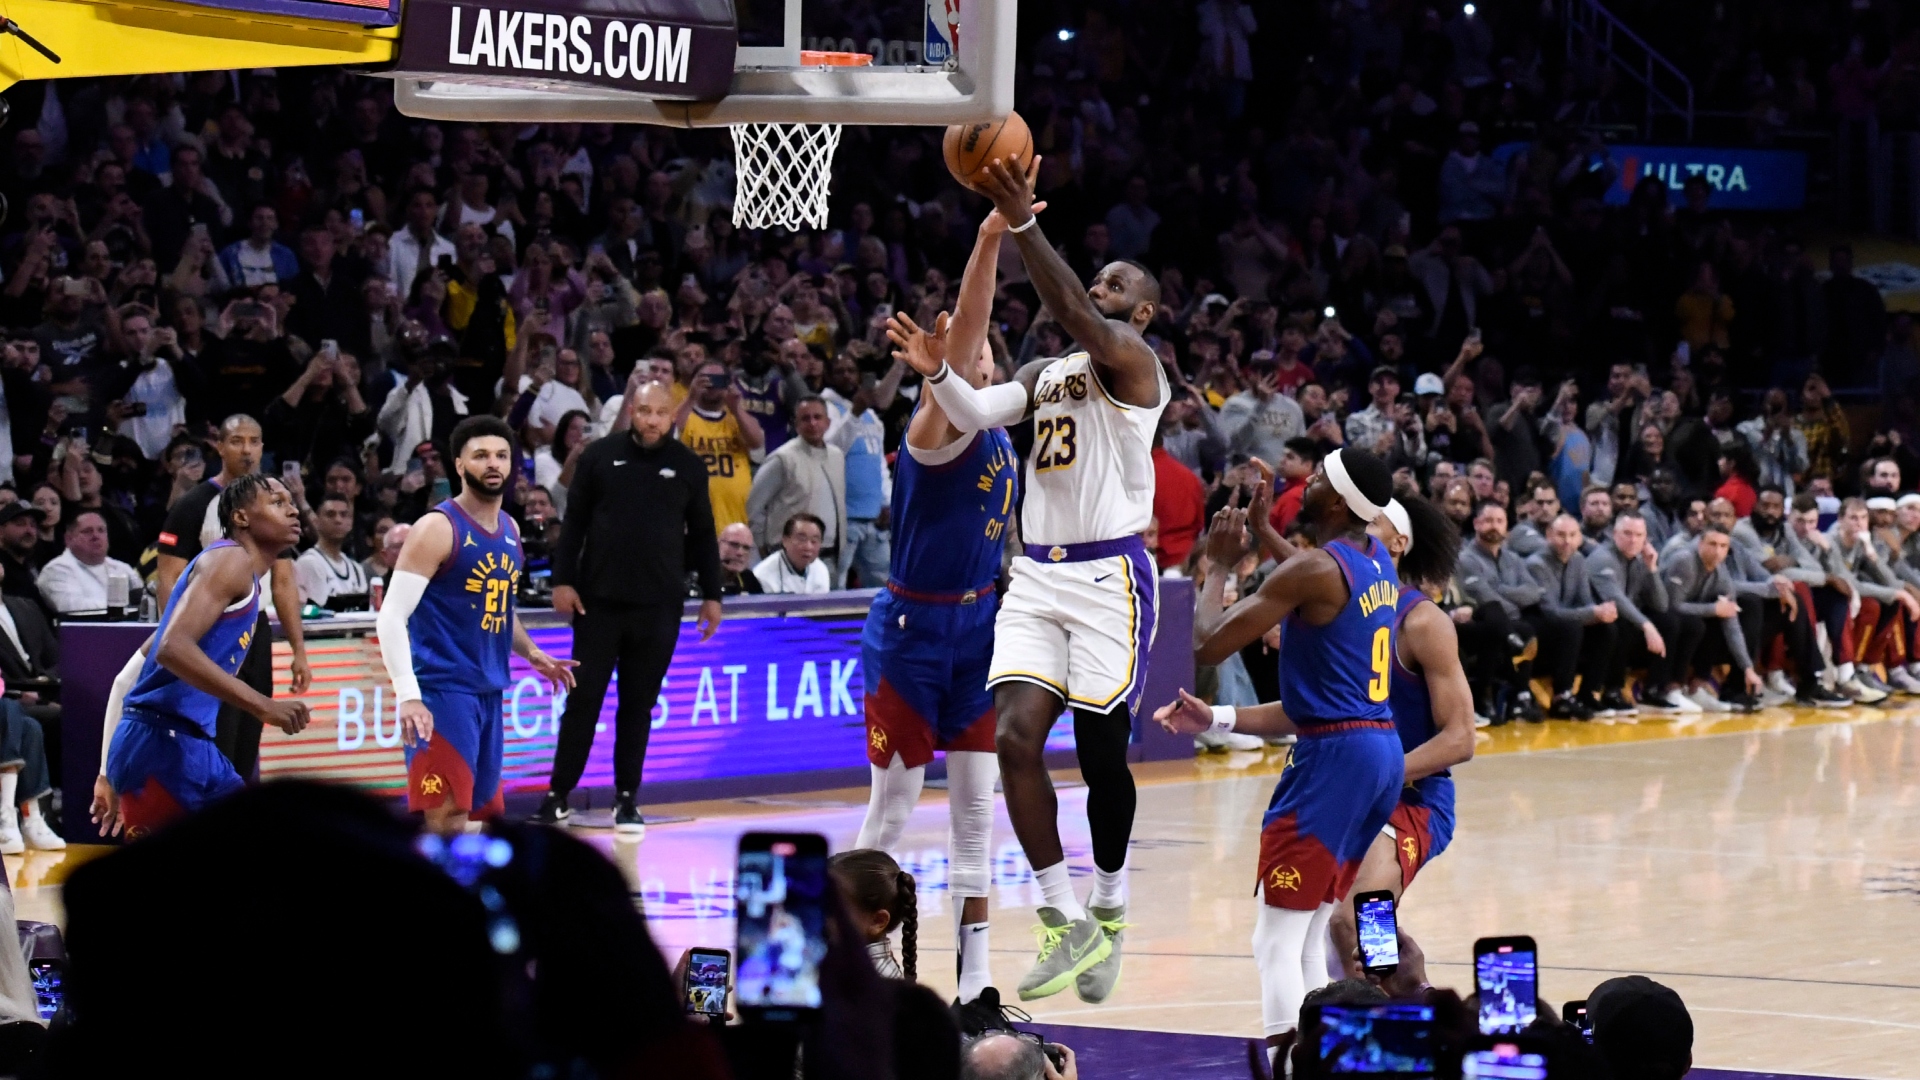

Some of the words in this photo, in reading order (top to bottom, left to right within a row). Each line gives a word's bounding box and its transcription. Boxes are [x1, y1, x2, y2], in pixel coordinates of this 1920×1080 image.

[449, 6, 692, 83] LAKERS.COM
[929, 42, 947, 58] NBA
[1035, 415, 1077, 474] 23
[702, 454, 734, 478] 20
[985, 518, 1005, 541] CIT
[465, 552, 498, 593] MILE
[485, 578, 510, 613] 27
[1368, 626, 1390, 702] 9
[337, 686, 402, 751] BU
[691, 665, 748, 726] AT
[766, 658, 865, 722] LAK
